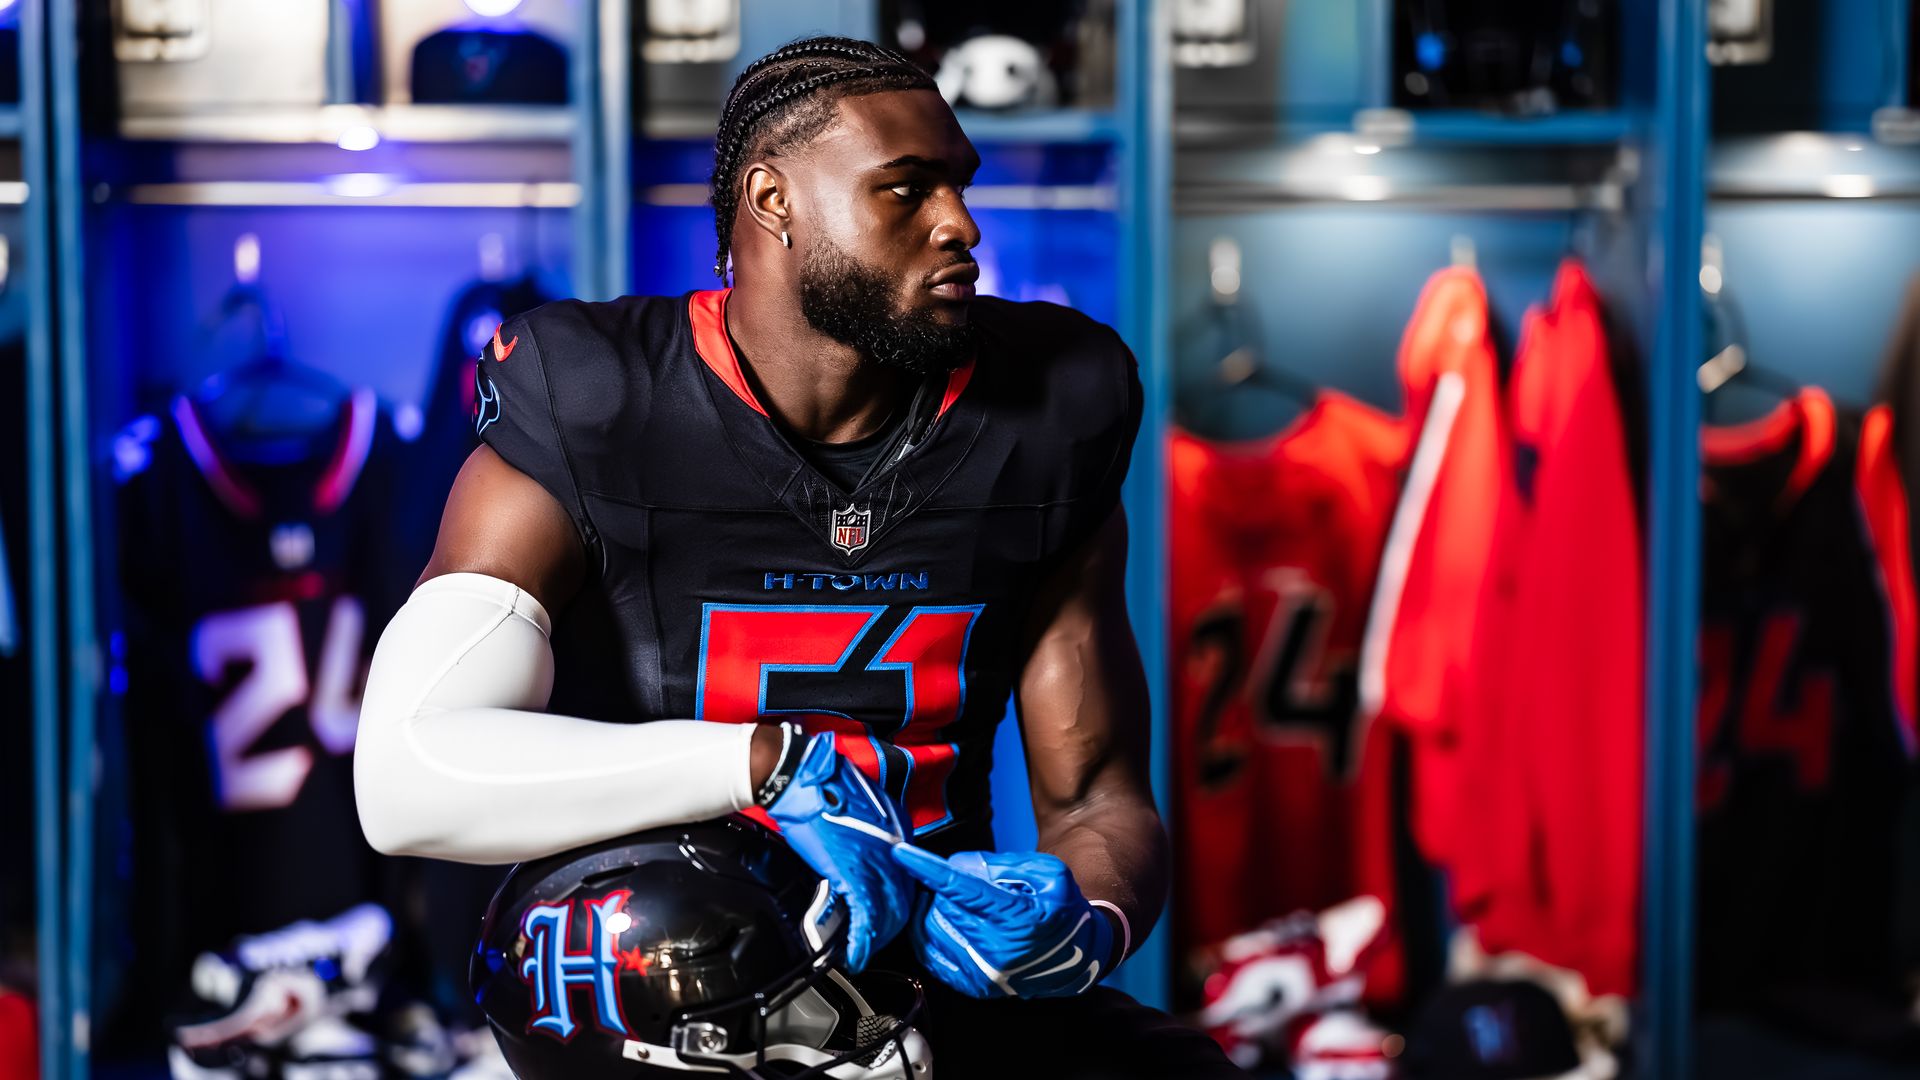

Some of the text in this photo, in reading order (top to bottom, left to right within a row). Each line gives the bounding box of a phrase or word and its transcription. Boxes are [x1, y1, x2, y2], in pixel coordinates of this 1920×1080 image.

[764, 572, 929, 591] H-TOWN
[837, 527, 864, 547] NFL
[695, 603, 986, 837] 51
[1188, 578, 1362, 790] 24
